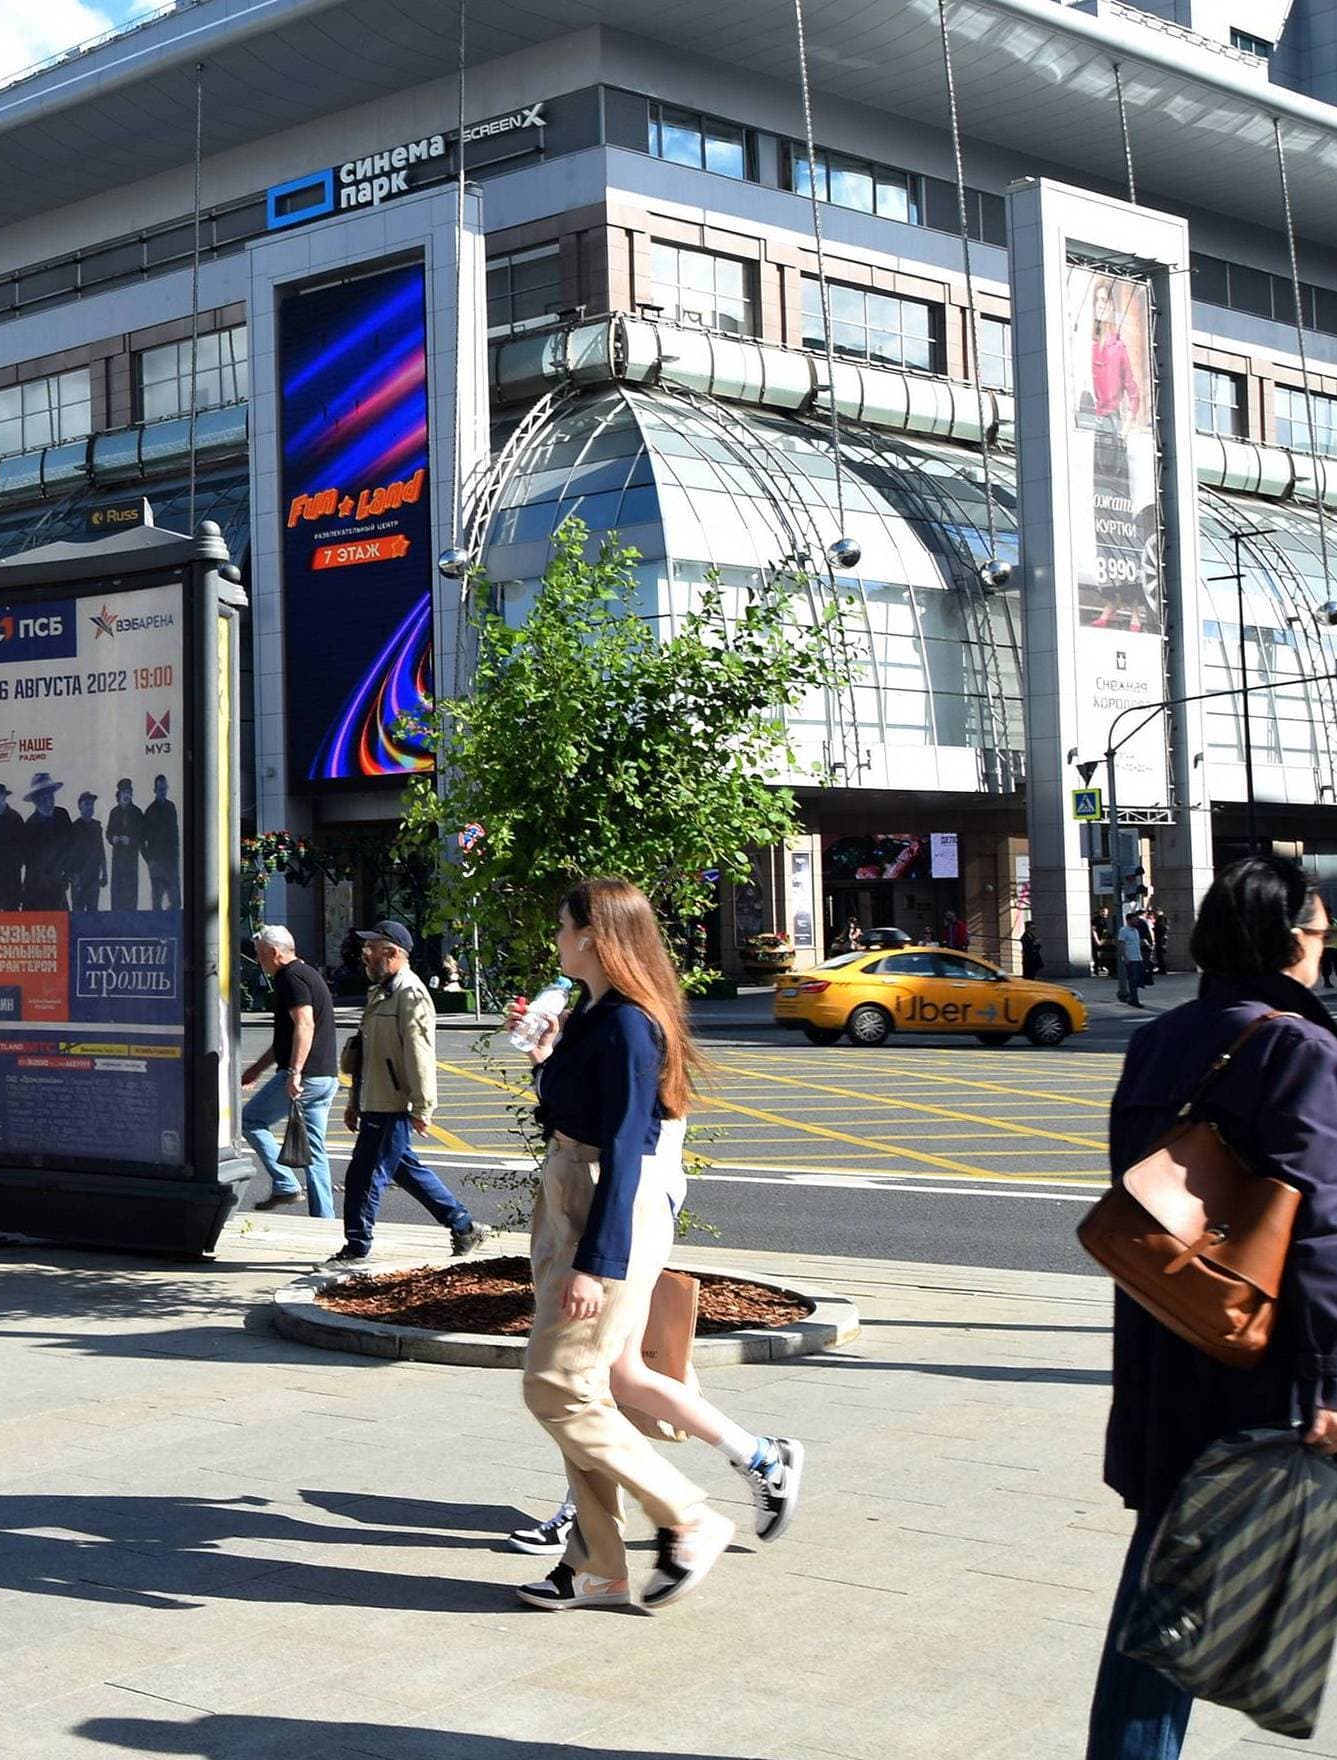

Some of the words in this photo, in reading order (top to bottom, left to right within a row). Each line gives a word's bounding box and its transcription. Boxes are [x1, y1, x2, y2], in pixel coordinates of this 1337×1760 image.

[462, 102, 546, 142] SCREENX
[341, 170, 409, 208] парк
[377, 520, 399, 531] ЦЕНТР
[1096, 518, 1137, 537] КУРТКИ
[324, 550, 333, 565] 7
[337, 543, 381, 562] ЭТАЖ
[19, 617, 63, 639] ПСБ
[14, 675, 82, 700] АВГУСТА
[87, 670, 127, 695] 2022
[133, 665, 173, 690] 19:00
[19, 738, 53, 752] НАШЕ
[145, 742, 171, 755] МУЗ
[19, 753, 46, 761] РАДИО
[896, 995, 973, 1022] Uber
